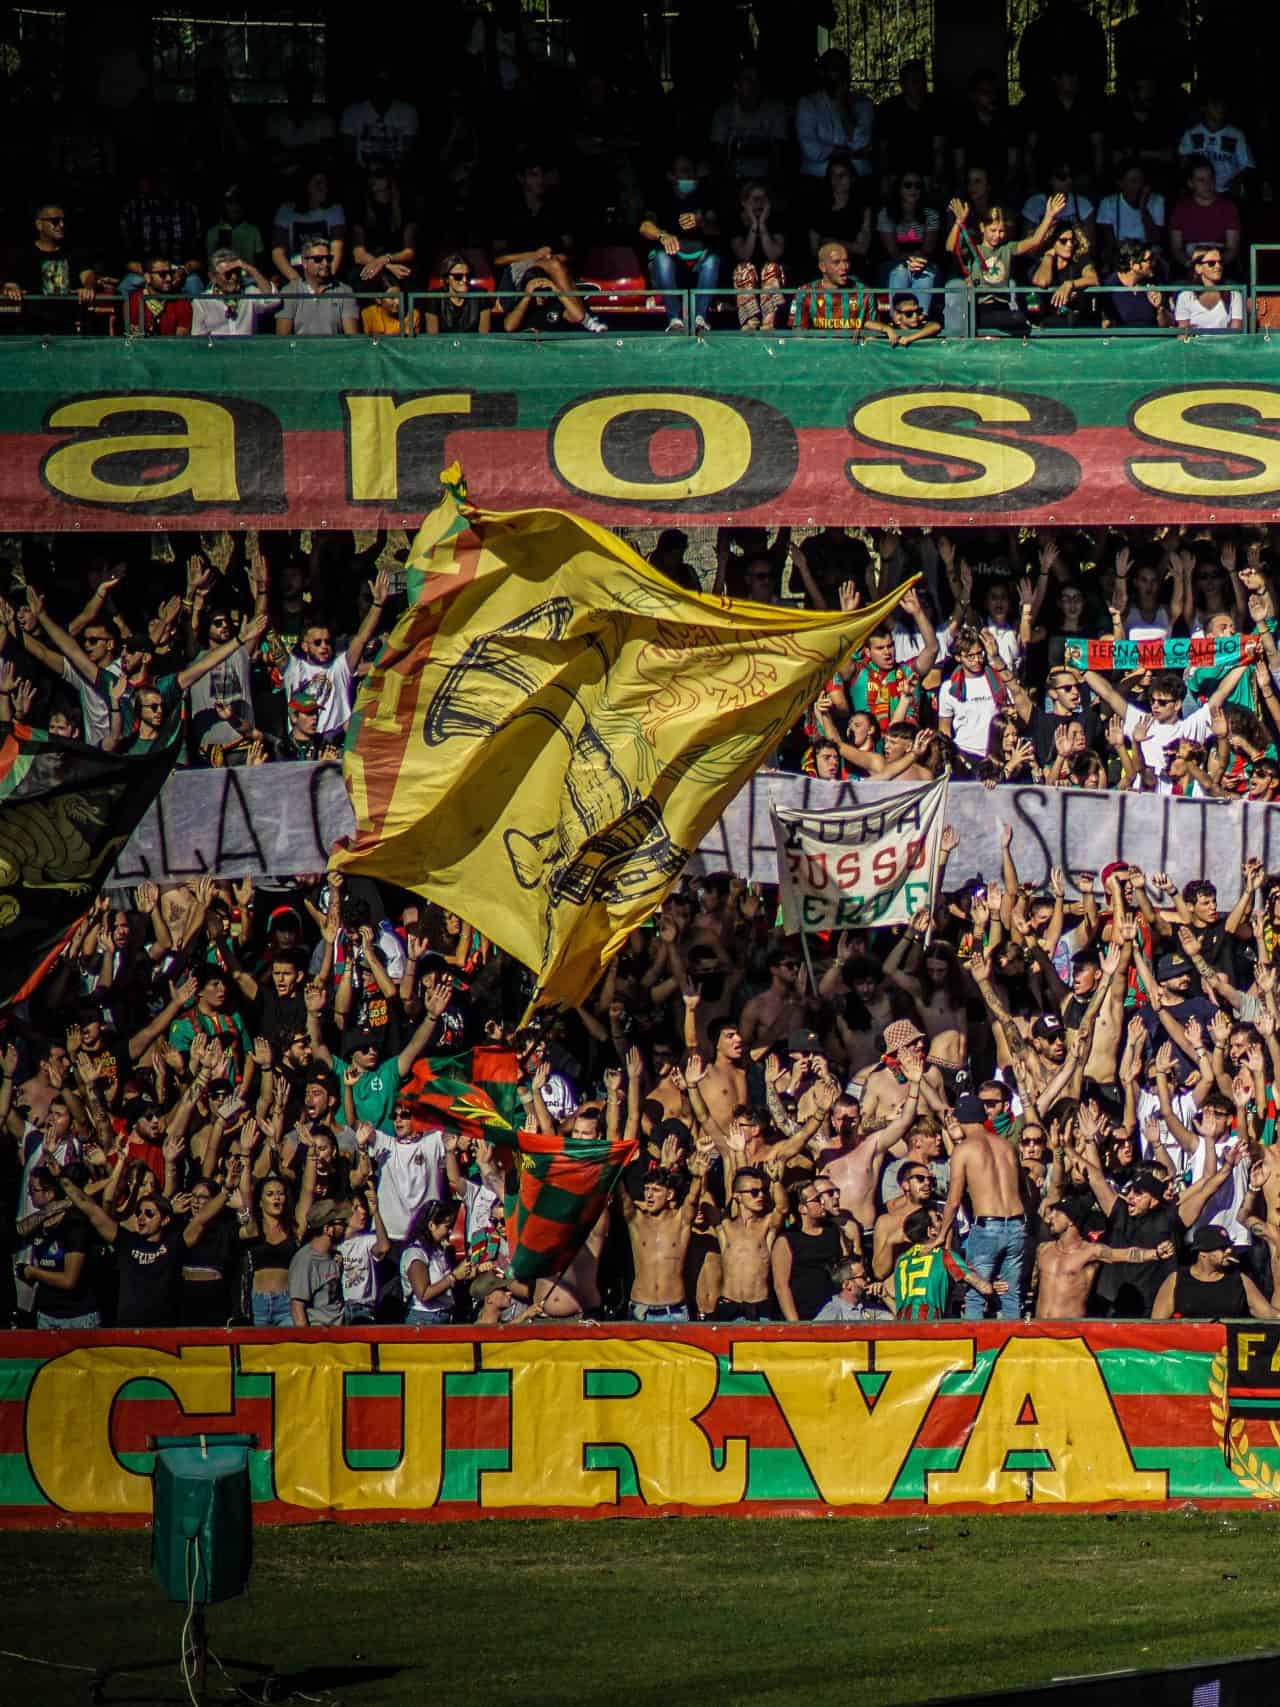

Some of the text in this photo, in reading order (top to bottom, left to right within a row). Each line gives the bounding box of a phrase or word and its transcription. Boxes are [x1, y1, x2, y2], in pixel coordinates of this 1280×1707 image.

[1090, 638, 1238, 660] TERNANA CALCIO
[899, 1254, 934, 1302] 12
[25, 1337, 1169, 1514] CURVA
